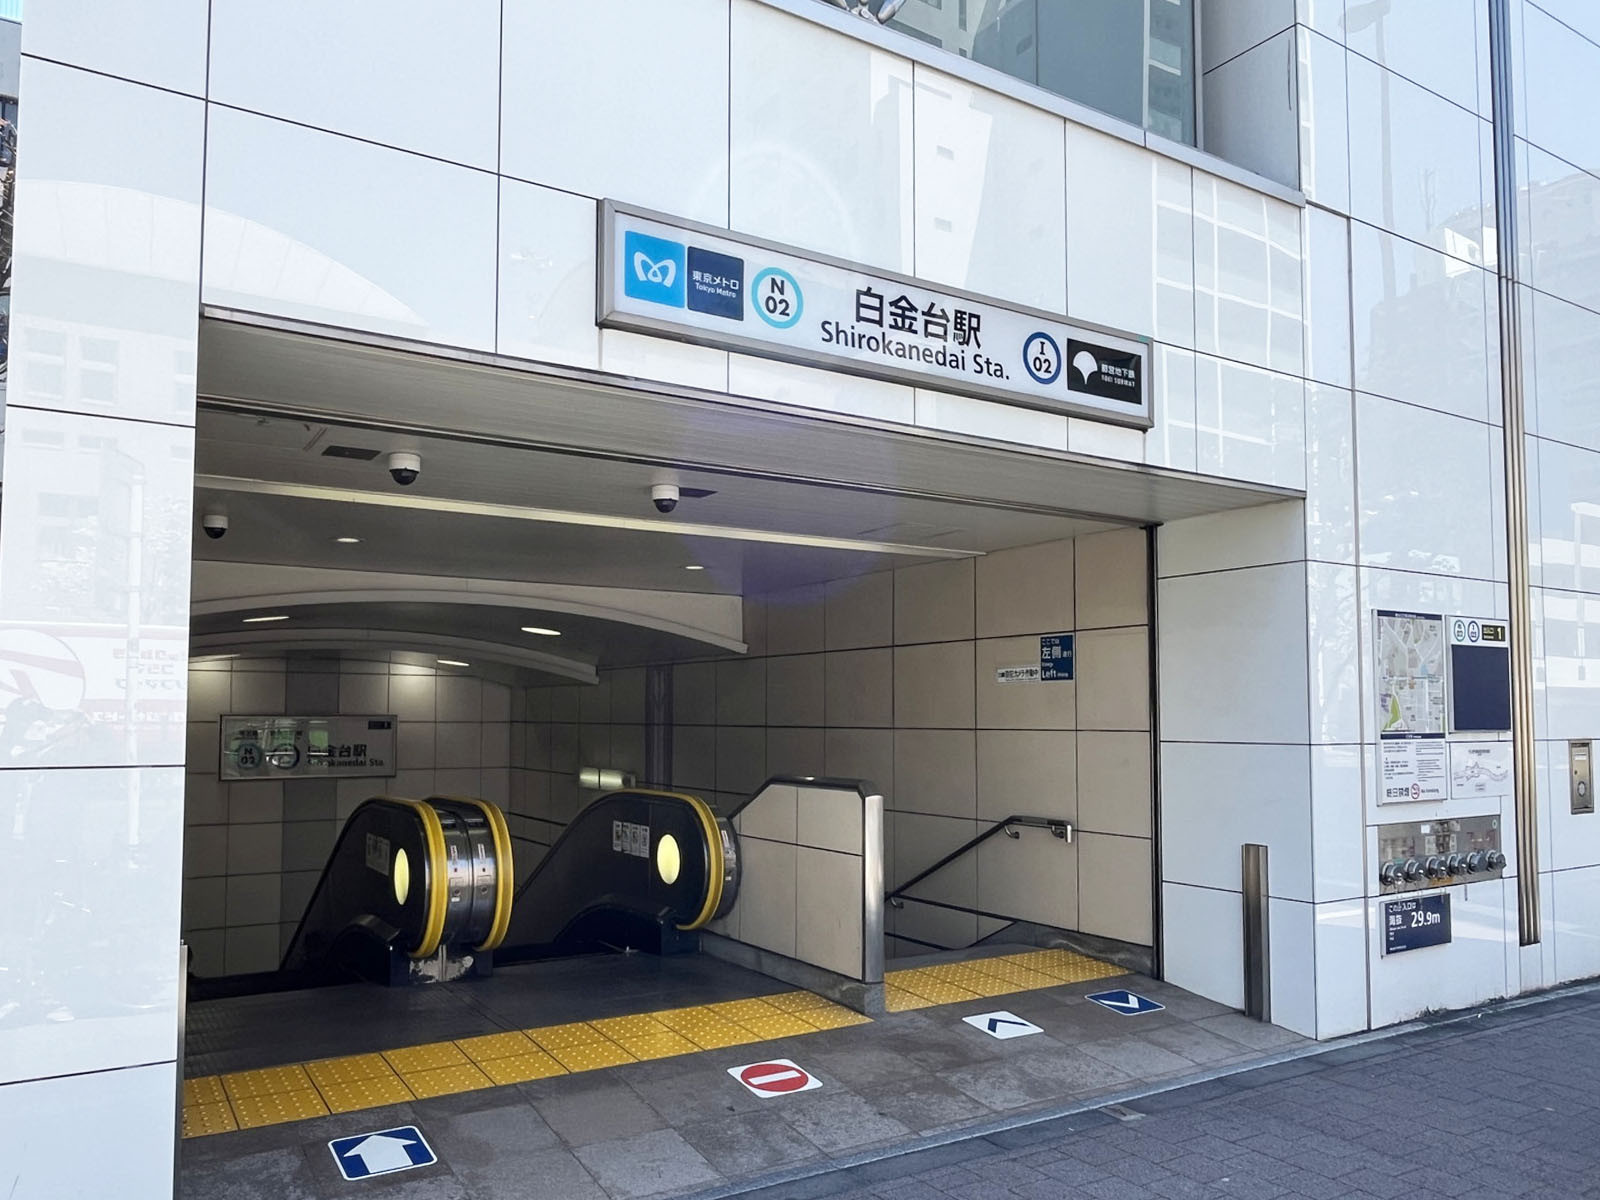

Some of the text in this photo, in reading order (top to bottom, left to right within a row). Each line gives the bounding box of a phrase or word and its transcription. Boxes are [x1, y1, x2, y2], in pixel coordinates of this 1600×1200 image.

[692, 270, 739, 290] 東京メトロ
[770, 277, 785, 295] N
[695, 282, 737, 298] Tokyo Metro
[765, 296, 790, 317] 02
[855, 286, 981, 349] 白金台駅
[821, 320, 1010, 381] Shirokanedai Sta.
[1039, 341, 1046, 356] I
[1033, 356, 1051, 374] 02
[1496, 627, 1502, 640] 1
[1041, 669, 1057, 679] Left
[1411, 911, 1440, 928] 29.9m
